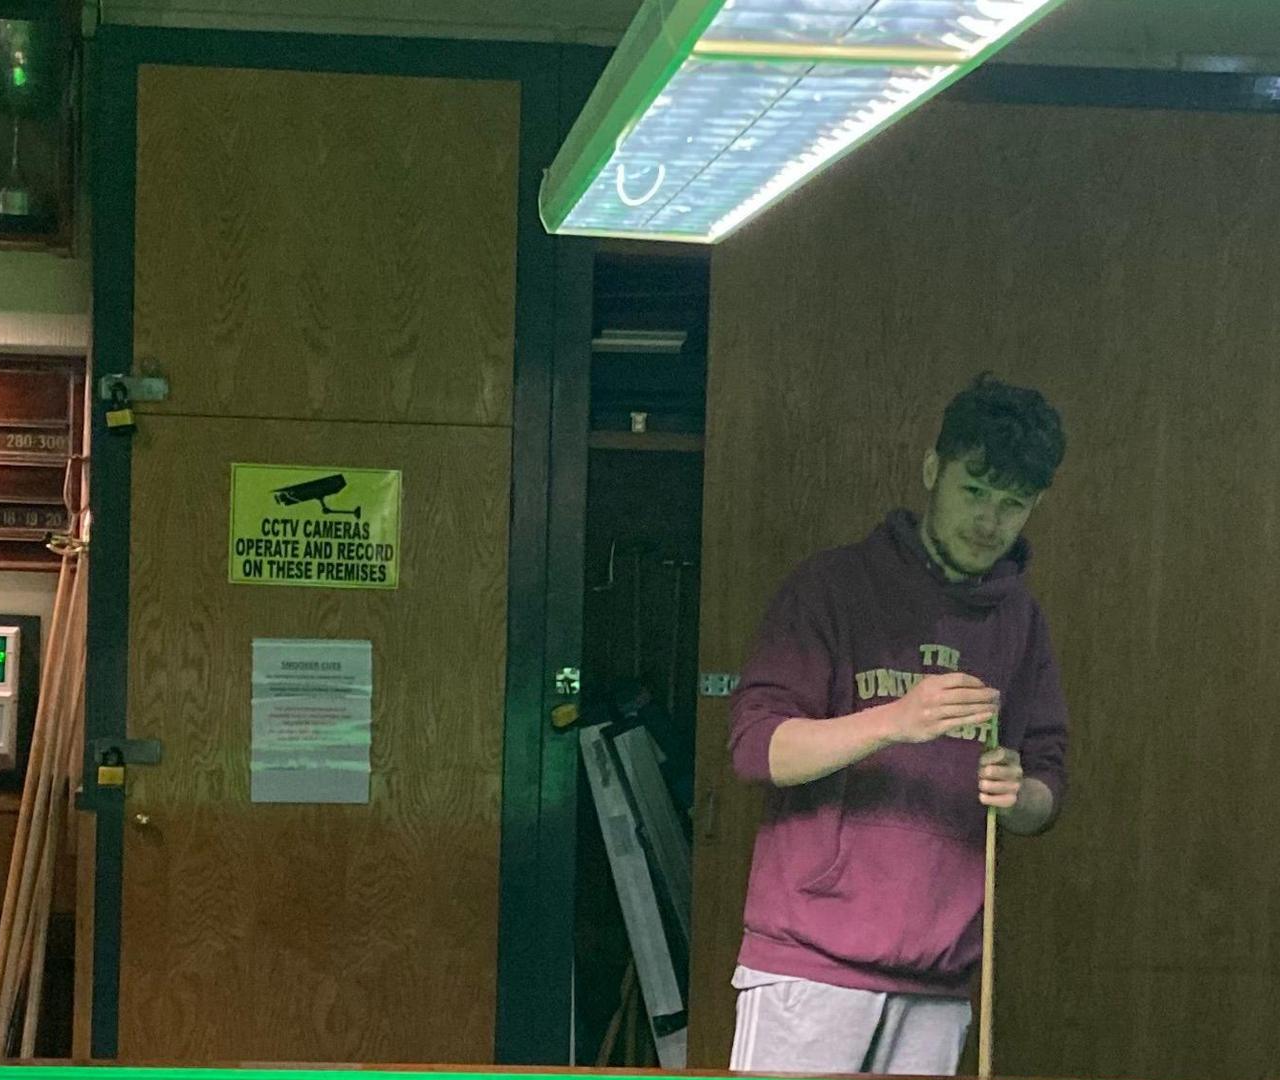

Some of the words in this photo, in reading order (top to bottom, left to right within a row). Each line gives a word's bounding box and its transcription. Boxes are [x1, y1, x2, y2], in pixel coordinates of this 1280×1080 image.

[6, 434, 32, 448] 280
[38, 435, 65, 450] 300
[261, 518, 300, 537] CCTV
[303, 519, 370, 540] CAMERAS
[235, 538, 300, 558] OPERATE
[303, 541, 333, 560] AND
[337, 542, 394, 562] RECORD
[242, 559, 263, 577] ON
[267, 560, 313, 579] THESE
[317, 562, 387, 582] PREMISES
[855, 668, 924, 700] UNIV
